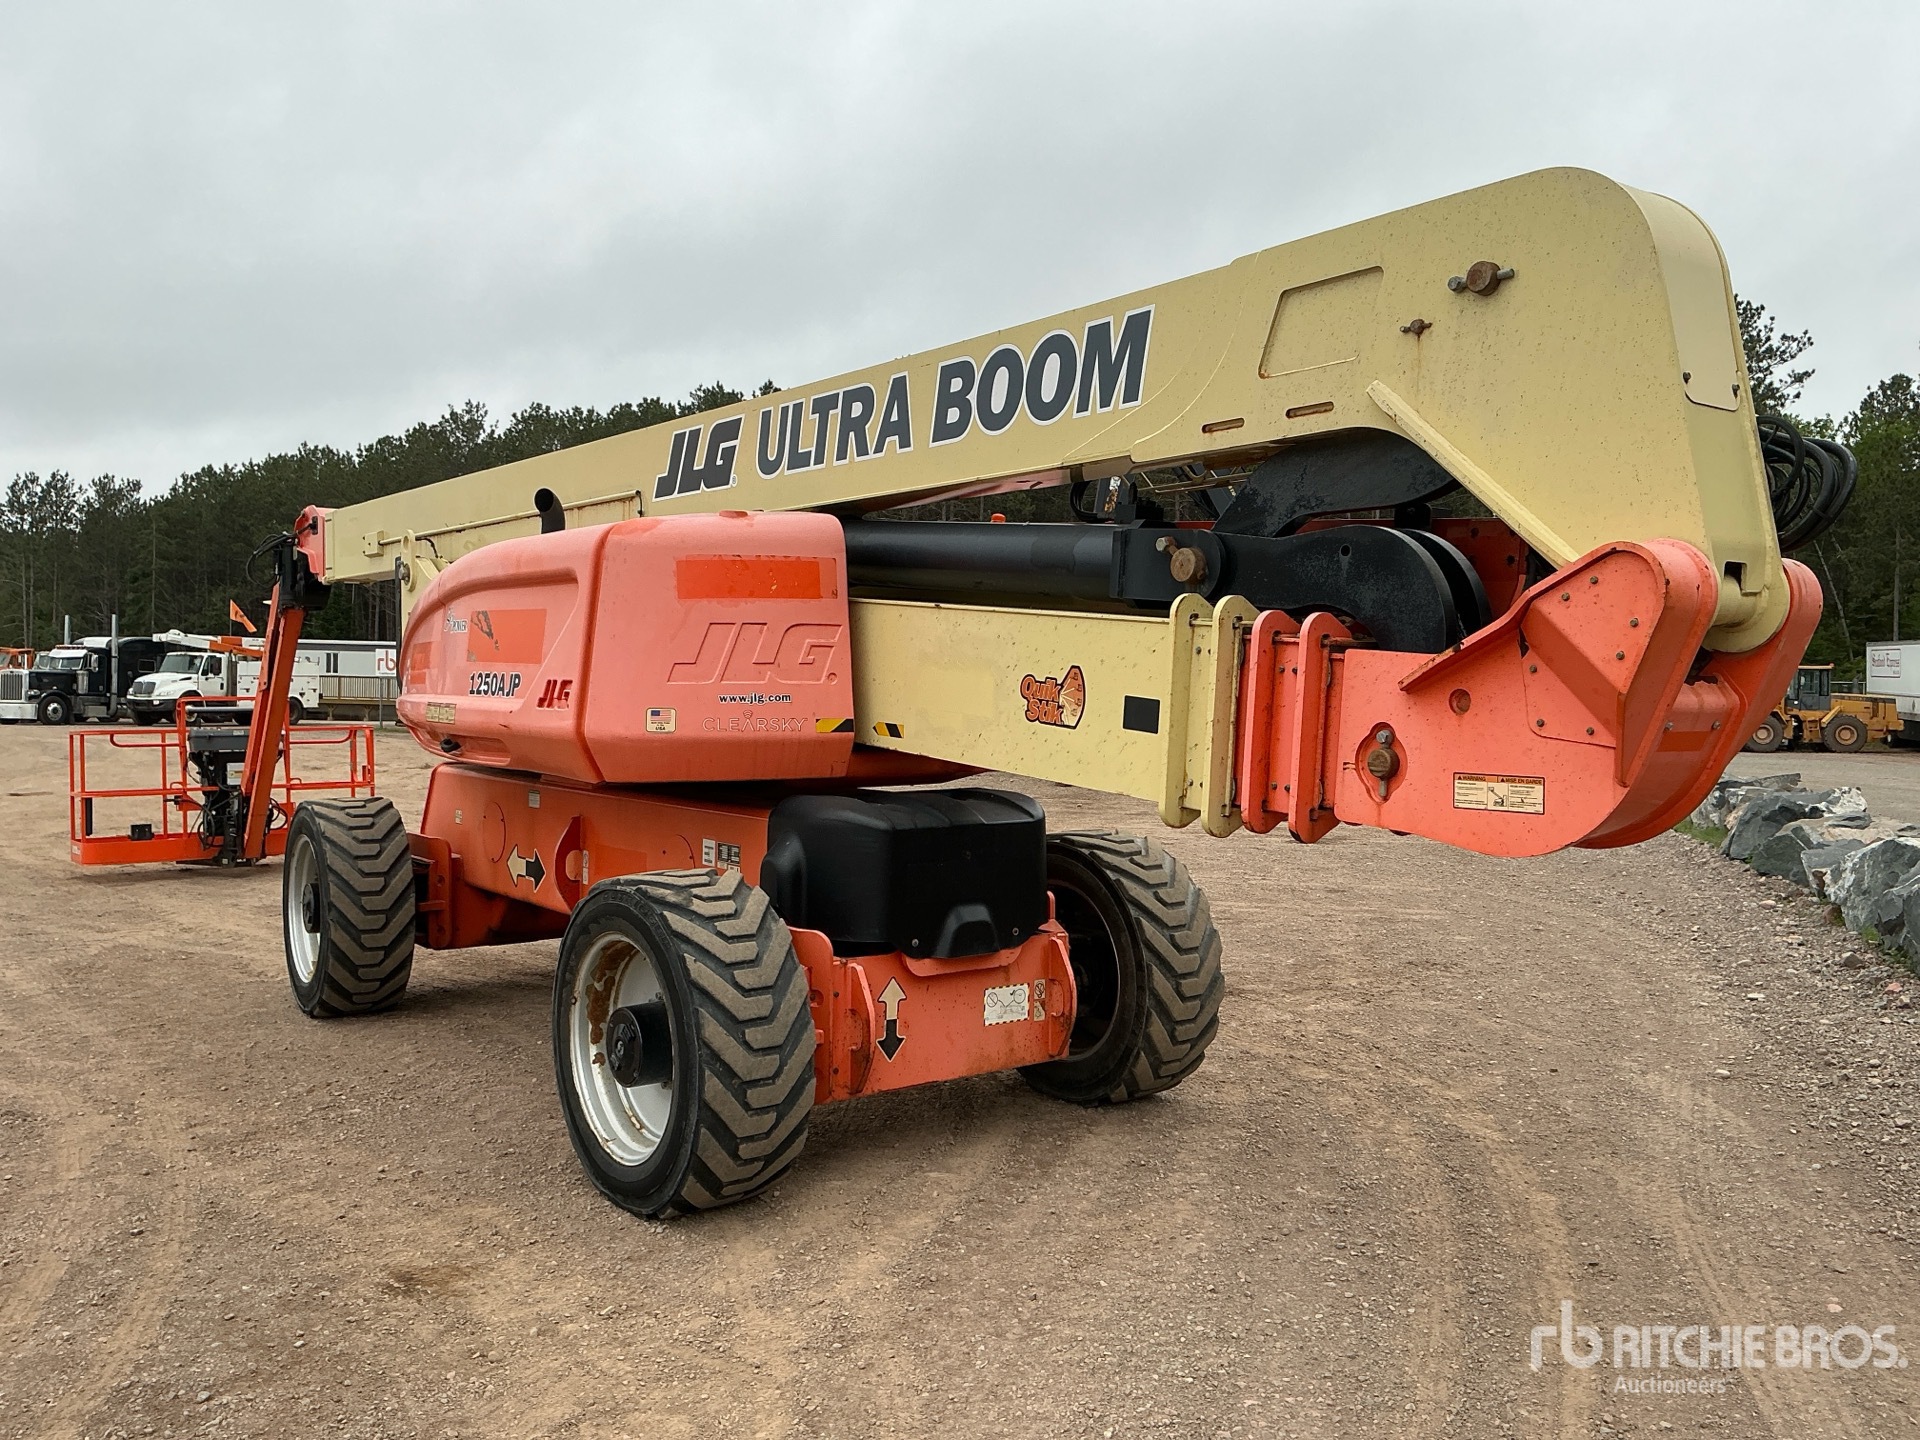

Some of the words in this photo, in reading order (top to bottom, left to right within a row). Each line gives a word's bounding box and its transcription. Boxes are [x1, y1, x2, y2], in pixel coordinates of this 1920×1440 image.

[653, 415, 743, 500] JLG
[757, 371, 913, 480] ULTRA
[929, 304, 1155, 448] BOOM
[377, 650, 396, 671] rb
[667, 622, 843, 685] JLG
[469, 672, 521, 697] 1250AJP
[536, 679, 573, 709] JLG
[1021, 676, 1061, 702] Quik
[718, 693, 792, 704] www.jlg.com
[1026, 699, 1063, 724] Stik
[702, 717, 808, 732] CLEARSKY
